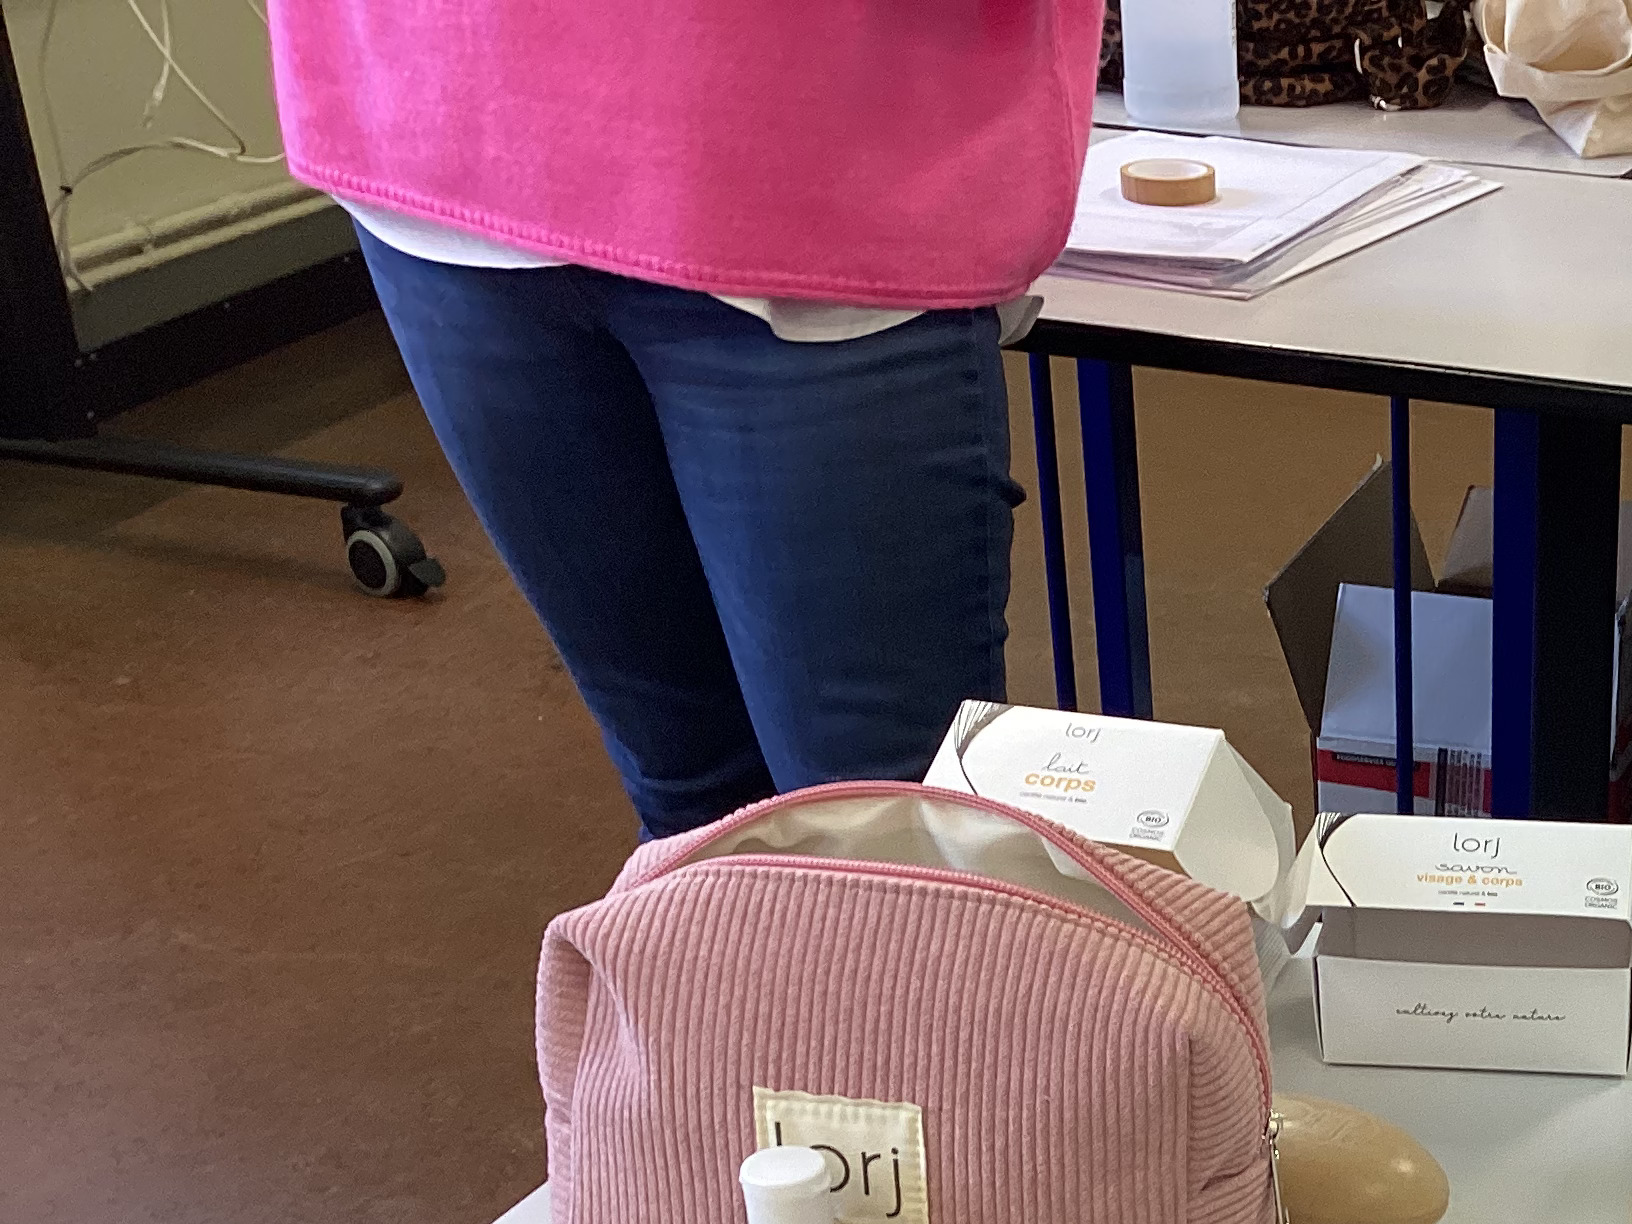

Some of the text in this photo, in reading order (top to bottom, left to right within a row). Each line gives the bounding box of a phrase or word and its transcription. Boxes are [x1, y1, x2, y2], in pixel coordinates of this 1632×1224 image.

[1065, 722, 1102, 743] lorj
[1041, 752, 1091, 775] lait
[1024, 773, 1097, 793] corps
[1452, 832, 1501, 859] lorj
[1434, 862, 1518, 875] savon
[1416, 872, 1523, 889] visage & corps
